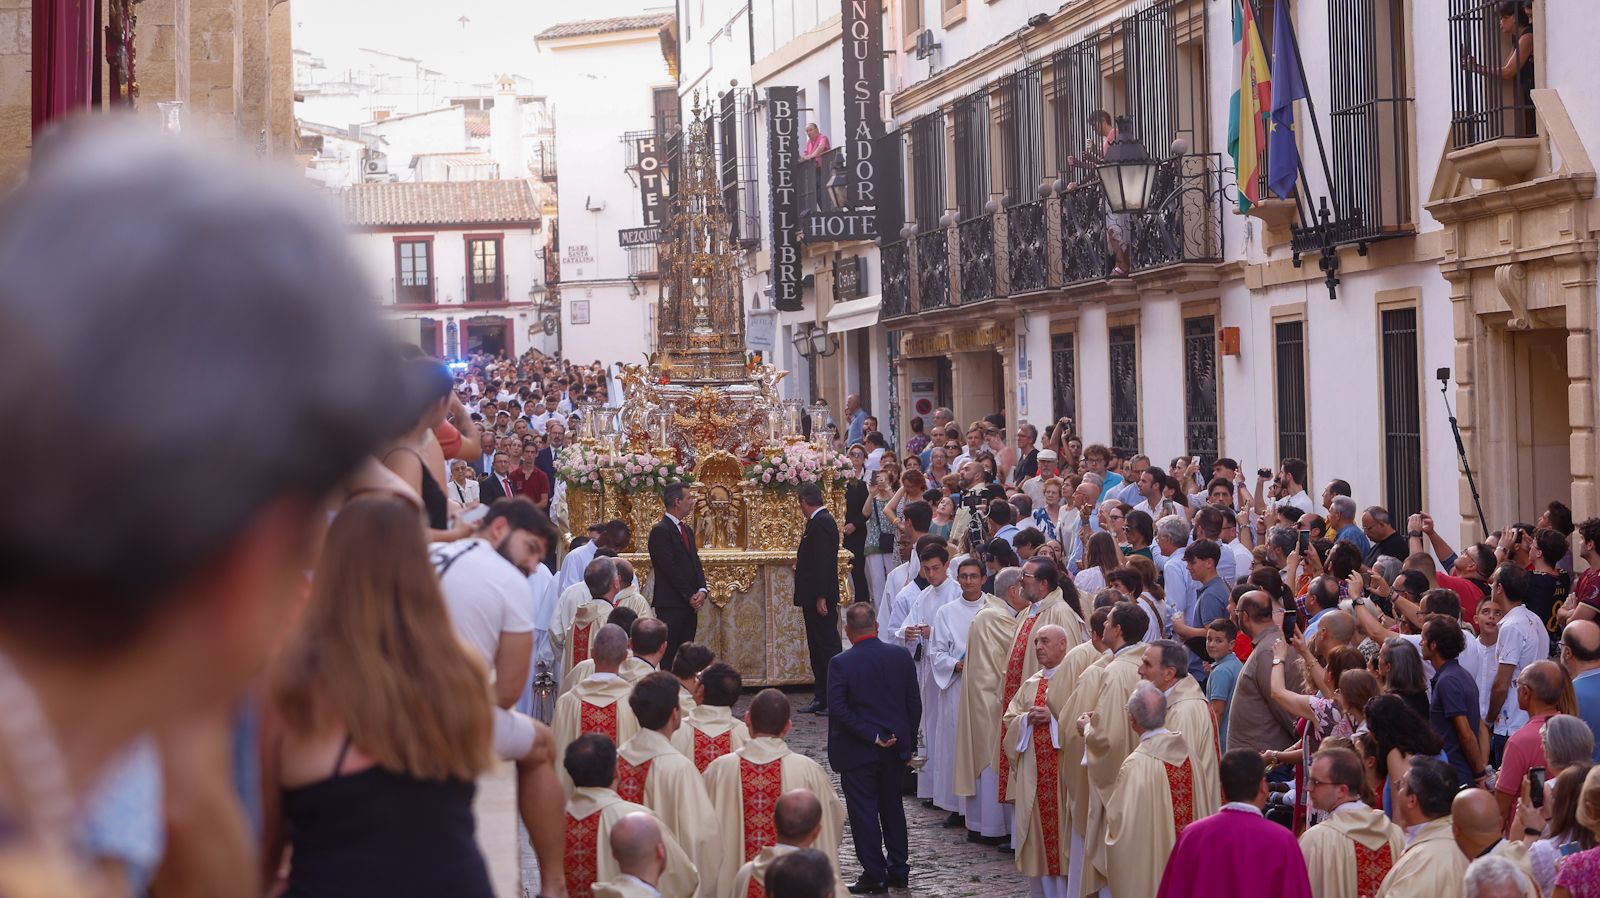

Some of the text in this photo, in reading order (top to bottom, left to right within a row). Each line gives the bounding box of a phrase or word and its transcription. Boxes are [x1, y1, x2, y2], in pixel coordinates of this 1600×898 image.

[640, 138, 661, 224] HOTEL
[774, 100, 797, 300] BUFFET LIBRE
[621, 228, 661, 244] MEZQUIT
[810, 215, 878, 236] HOTE
